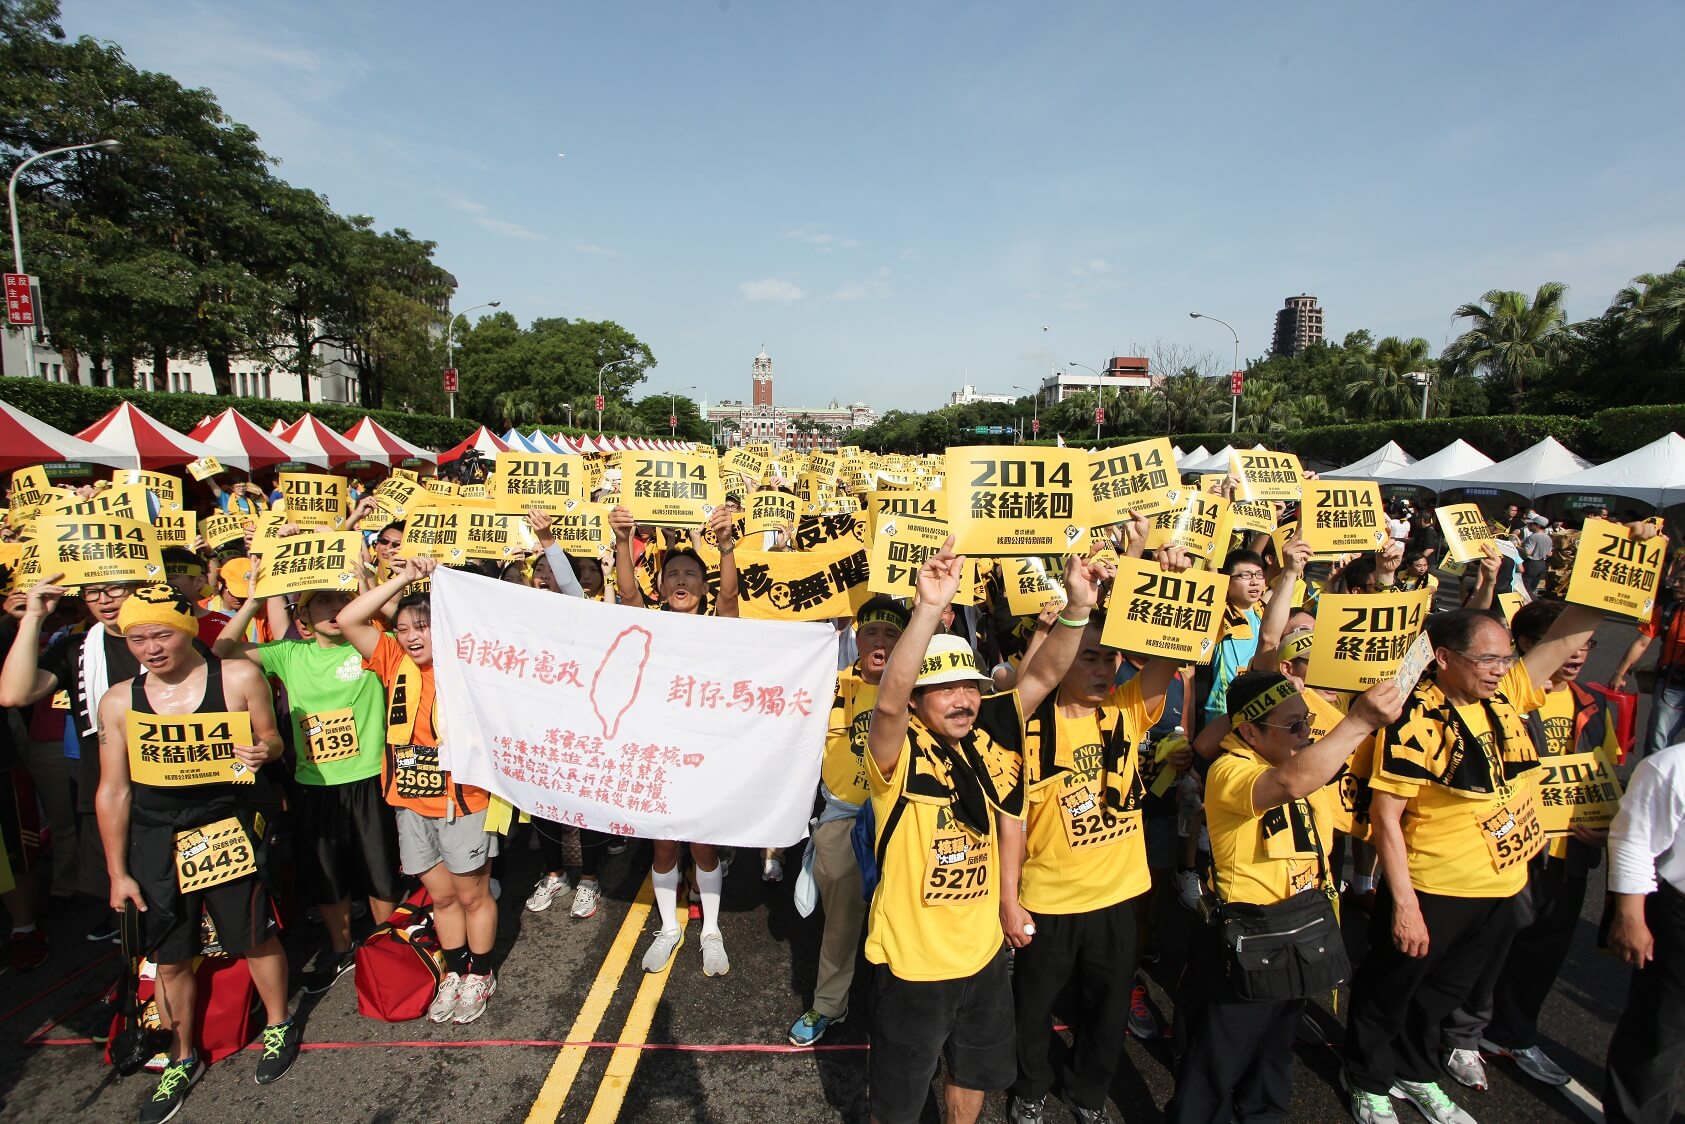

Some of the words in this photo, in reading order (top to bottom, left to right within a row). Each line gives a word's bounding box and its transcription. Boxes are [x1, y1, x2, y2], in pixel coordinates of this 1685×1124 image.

[507, 460, 570, 478] 2014
[735, 451, 762, 467] 2014
[812, 456, 835, 468] 2014
[1088, 448, 1164, 481] 2014
[1242, 456, 1293, 469] 2014
[635, 459, 706, 481] 2014
[970, 460, 1073, 488] 2014
[1245, 469, 1298, 483] 終結核四
[285, 480, 338, 497] 2014
[428, 483, 452, 493] 2014
[507, 479, 570, 495] 終結核四
[634, 479, 707, 500] 終結核四
[1092, 469, 1168, 502] 終結核四
[286, 496, 338, 513] 終結核四
[752, 495, 795, 510] 2014
[877, 499, 936, 514] 2014
[971, 491, 1073, 519] 終結核四
[1316, 490, 1374, 508] 2014
[411, 513, 458, 528] 2014
[470, 513, 509, 528] 014
[752, 507, 796, 522] 終結核四
[1233, 504, 1272, 521] 終結核四
[1316, 510, 1376, 528] 終結核四
[56, 523, 146, 543] 2014
[406, 528, 457, 545] 終結核四
[468, 528, 507, 543] 結核四
[551, 528, 602, 541] 終結核四
[58, 543, 149, 562] 終結核四
[275, 538, 346, 560] 2014
[1597, 533, 1661, 569] 2014
[271, 555, 345, 576] 終結核四
[1590, 558, 1655, 592] 終結核四
[1133, 571, 1215, 606] 2014
[1127, 598, 1212, 632] 終結核四
[1339, 603, 1421, 632] 2014
[1334, 631, 1416, 661] 終結核四
[1240, 694, 1275, 720] 2014
[138, 721, 233, 743] 2014
[1311, 728, 1326, 737] FEAR
[1551, 718, 1569, 727] NO
[140, 742, 236, 763] 終結核四
[1080, 745, 1097, 757] NO
[396, 768, 442, 788] 2569
[1539, 761, 1609, 785] 2014
[1540, 782, 1618, 807] 終結核四
[1072, 812, 1129, 837] 526
[1497, 817, 1541, 859] 5345
[181, 845, 249, 878] 0443
[929, 864, 986, 889] 5270
